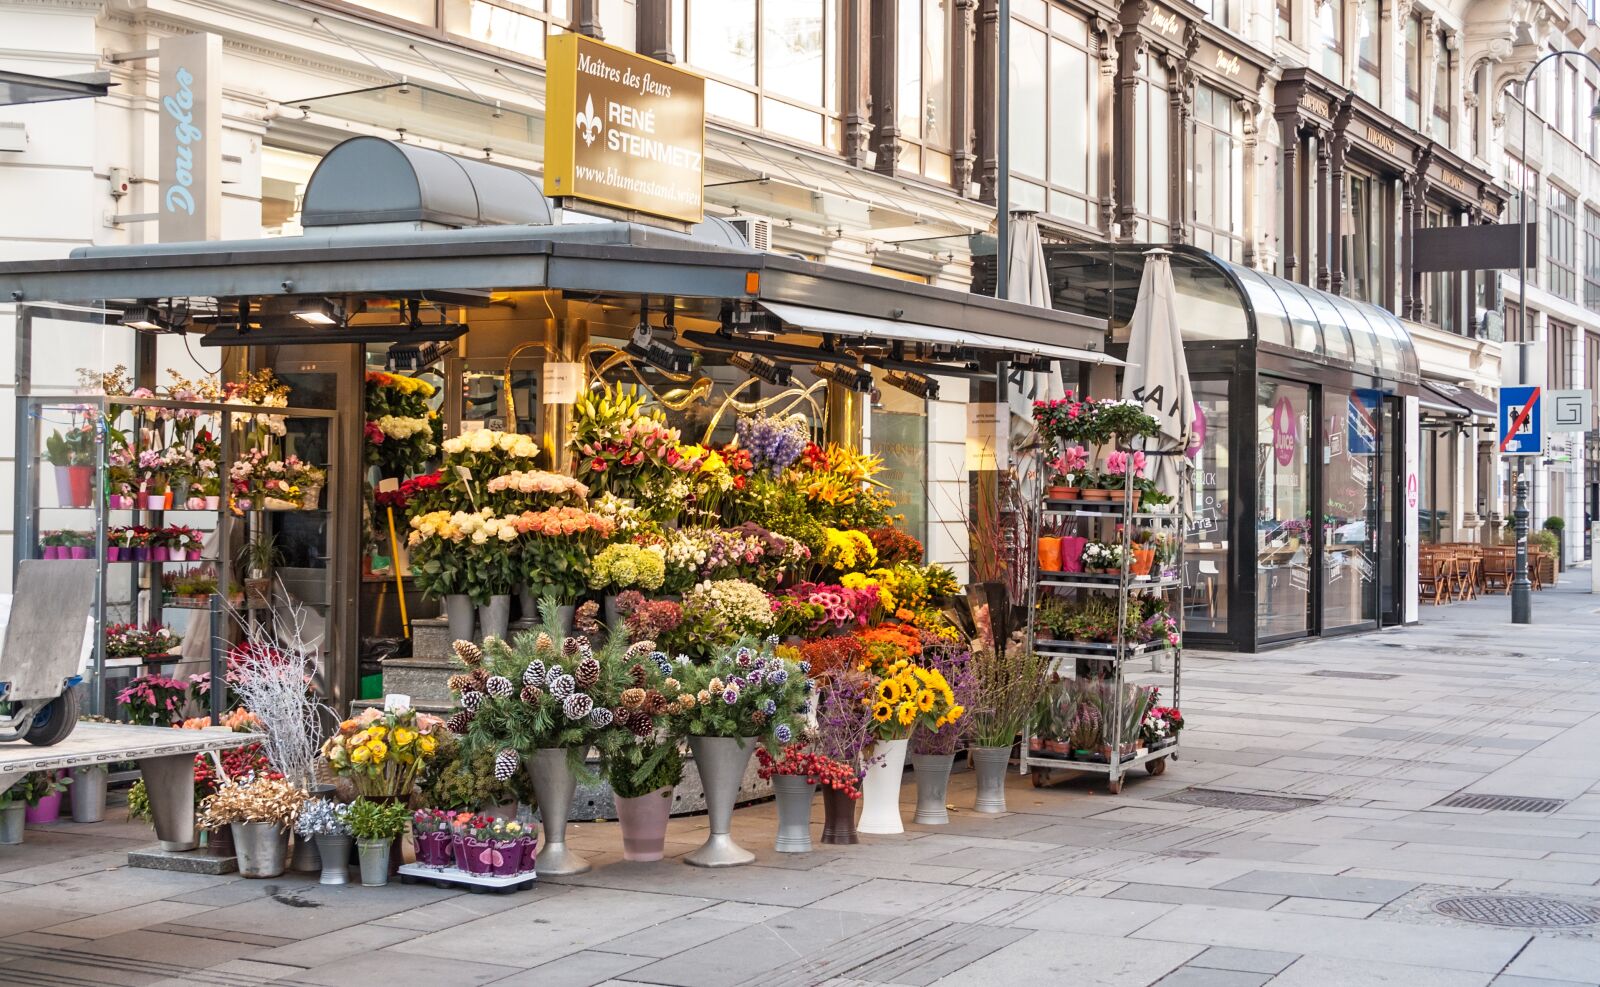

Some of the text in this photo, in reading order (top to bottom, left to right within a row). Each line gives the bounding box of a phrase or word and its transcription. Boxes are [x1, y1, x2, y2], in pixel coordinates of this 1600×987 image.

[577, 53, 672, 98] Maîtres des fleurs
[608, 101, 655, 134] RENÉ
[163, 66, 202, 216] Douglas
[607, 129, 701, 172] STEINMETZ
[576, 165, 701, 206] www.blumenstand.wien
